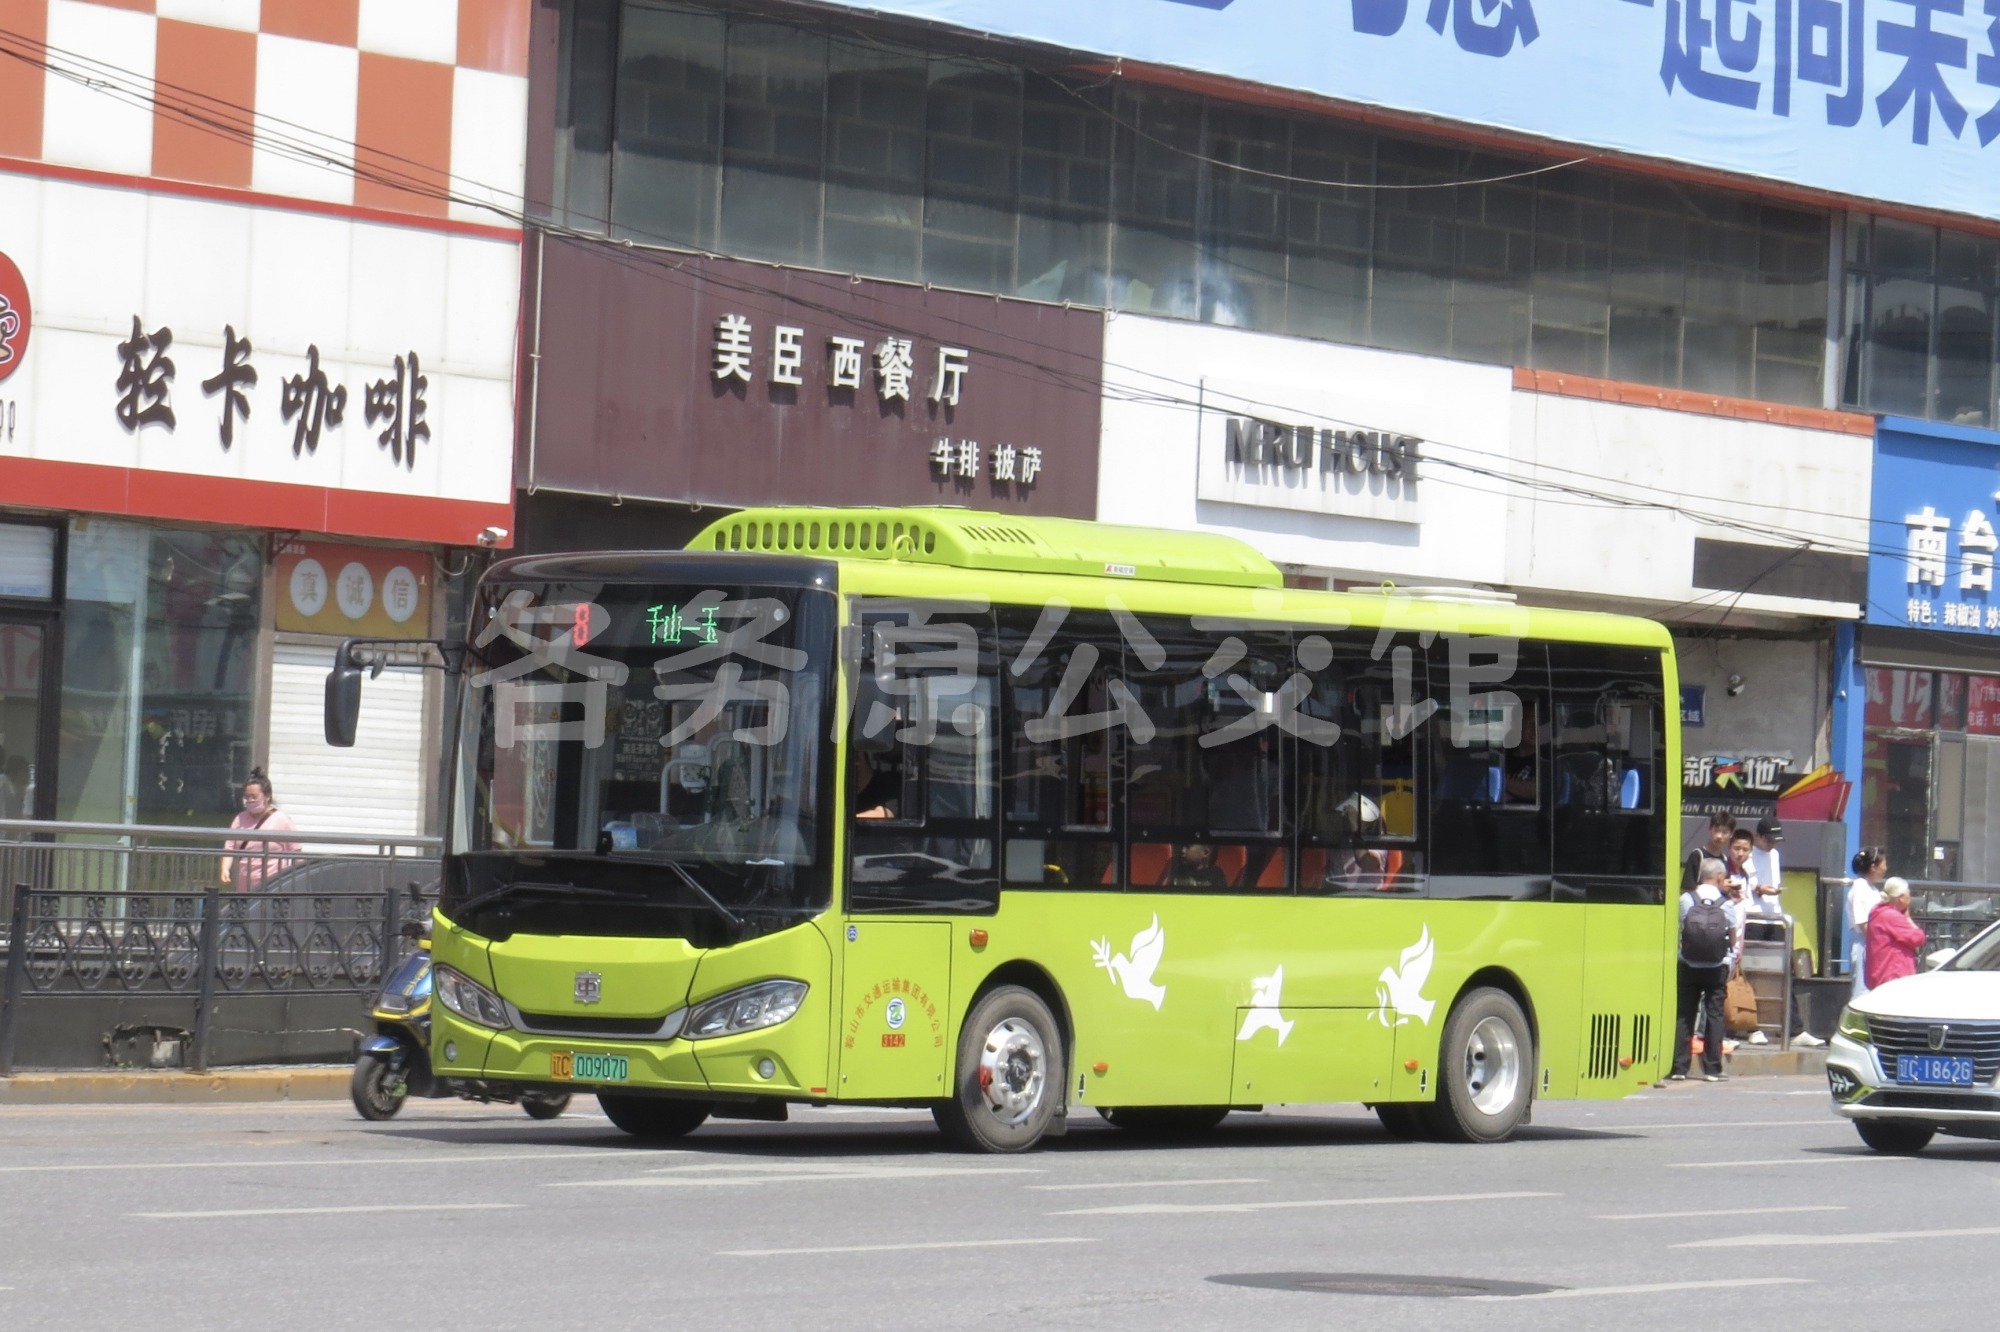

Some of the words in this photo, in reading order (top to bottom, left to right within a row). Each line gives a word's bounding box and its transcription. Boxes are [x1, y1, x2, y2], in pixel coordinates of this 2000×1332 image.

[115, 314, 431, 469] 轻卡咖啡
[714, 314, 969, 406] 美臣西餐厅
[933, 437, 980, 479] 牛排
[991, 443, 1042, 484] 披萨
[1320, 428, 1424, 482] HOUSE
